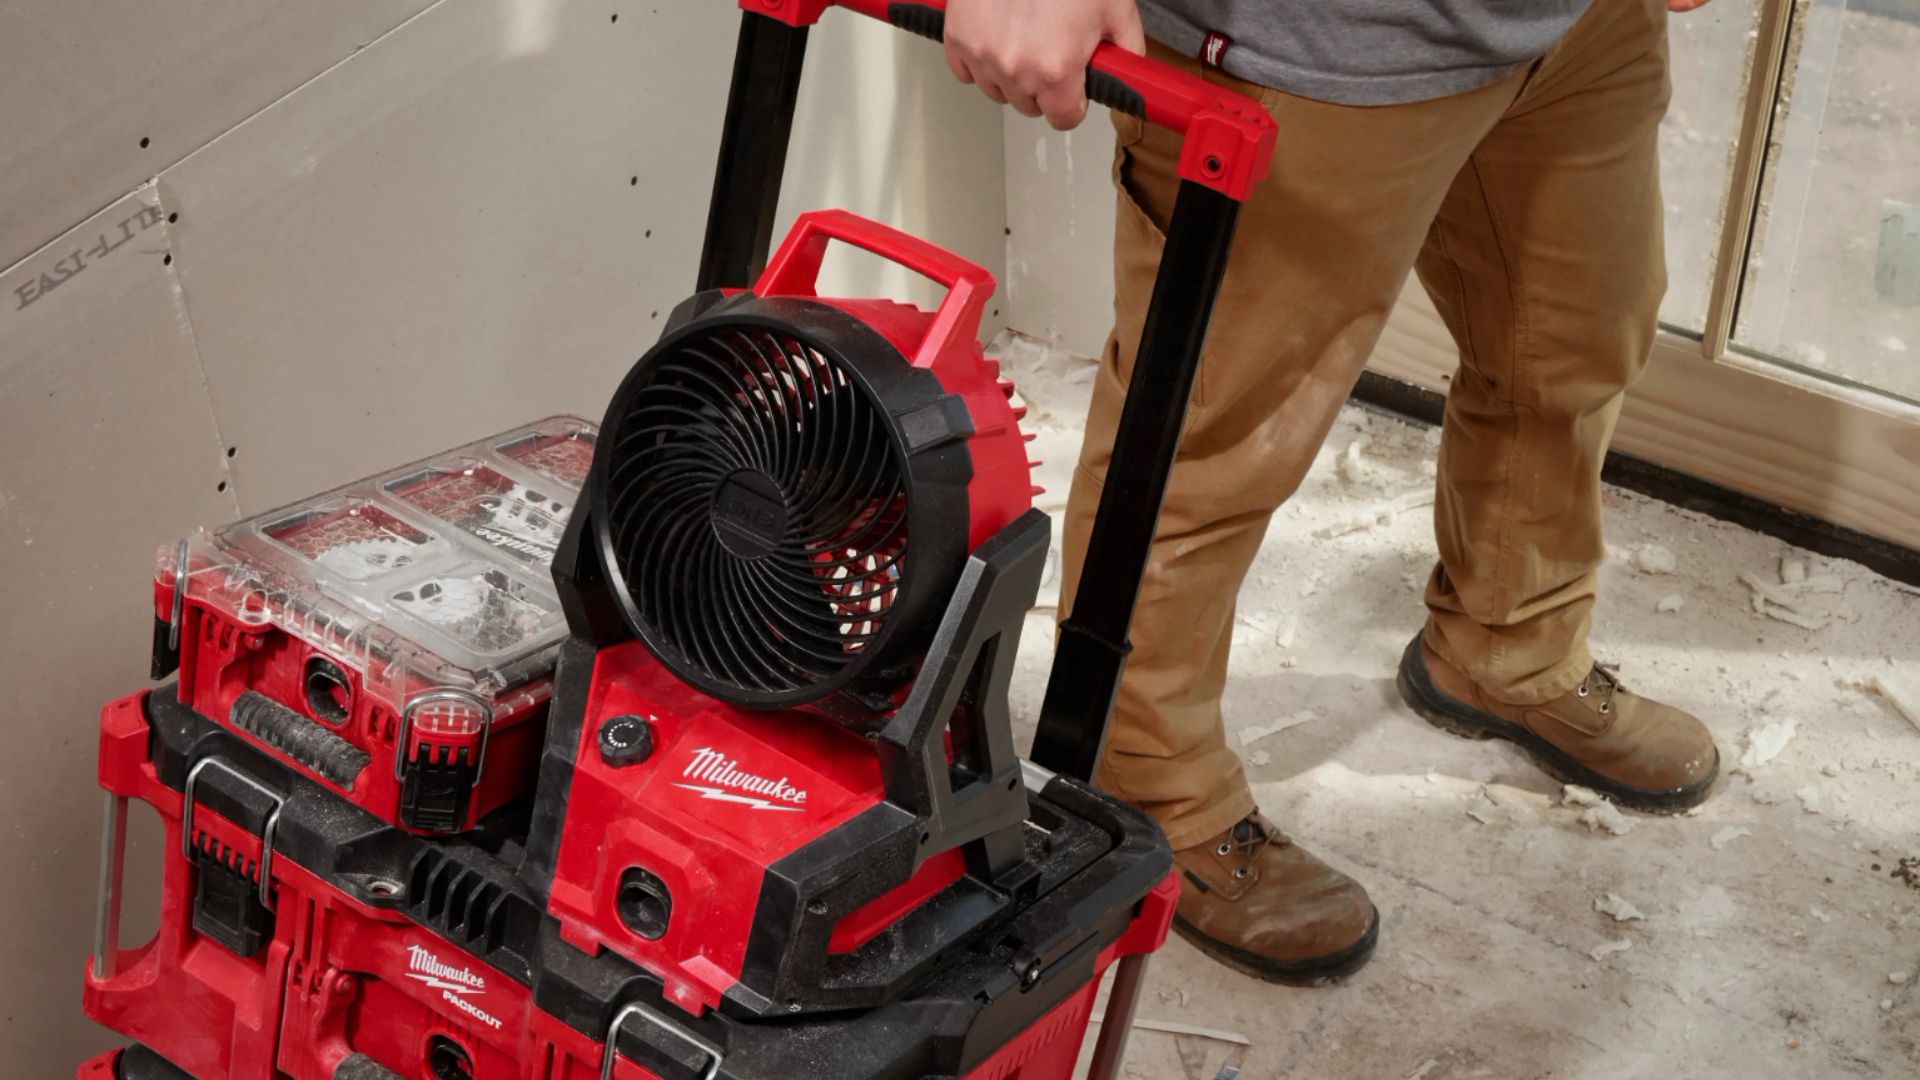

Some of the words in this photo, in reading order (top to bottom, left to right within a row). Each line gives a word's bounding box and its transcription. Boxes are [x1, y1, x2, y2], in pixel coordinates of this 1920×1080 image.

[683, 747, 806, 803] Milwaukee
[407, 944, 484, 988] Milwaukee
[443, 990, 502, 1029] PACKOUT
